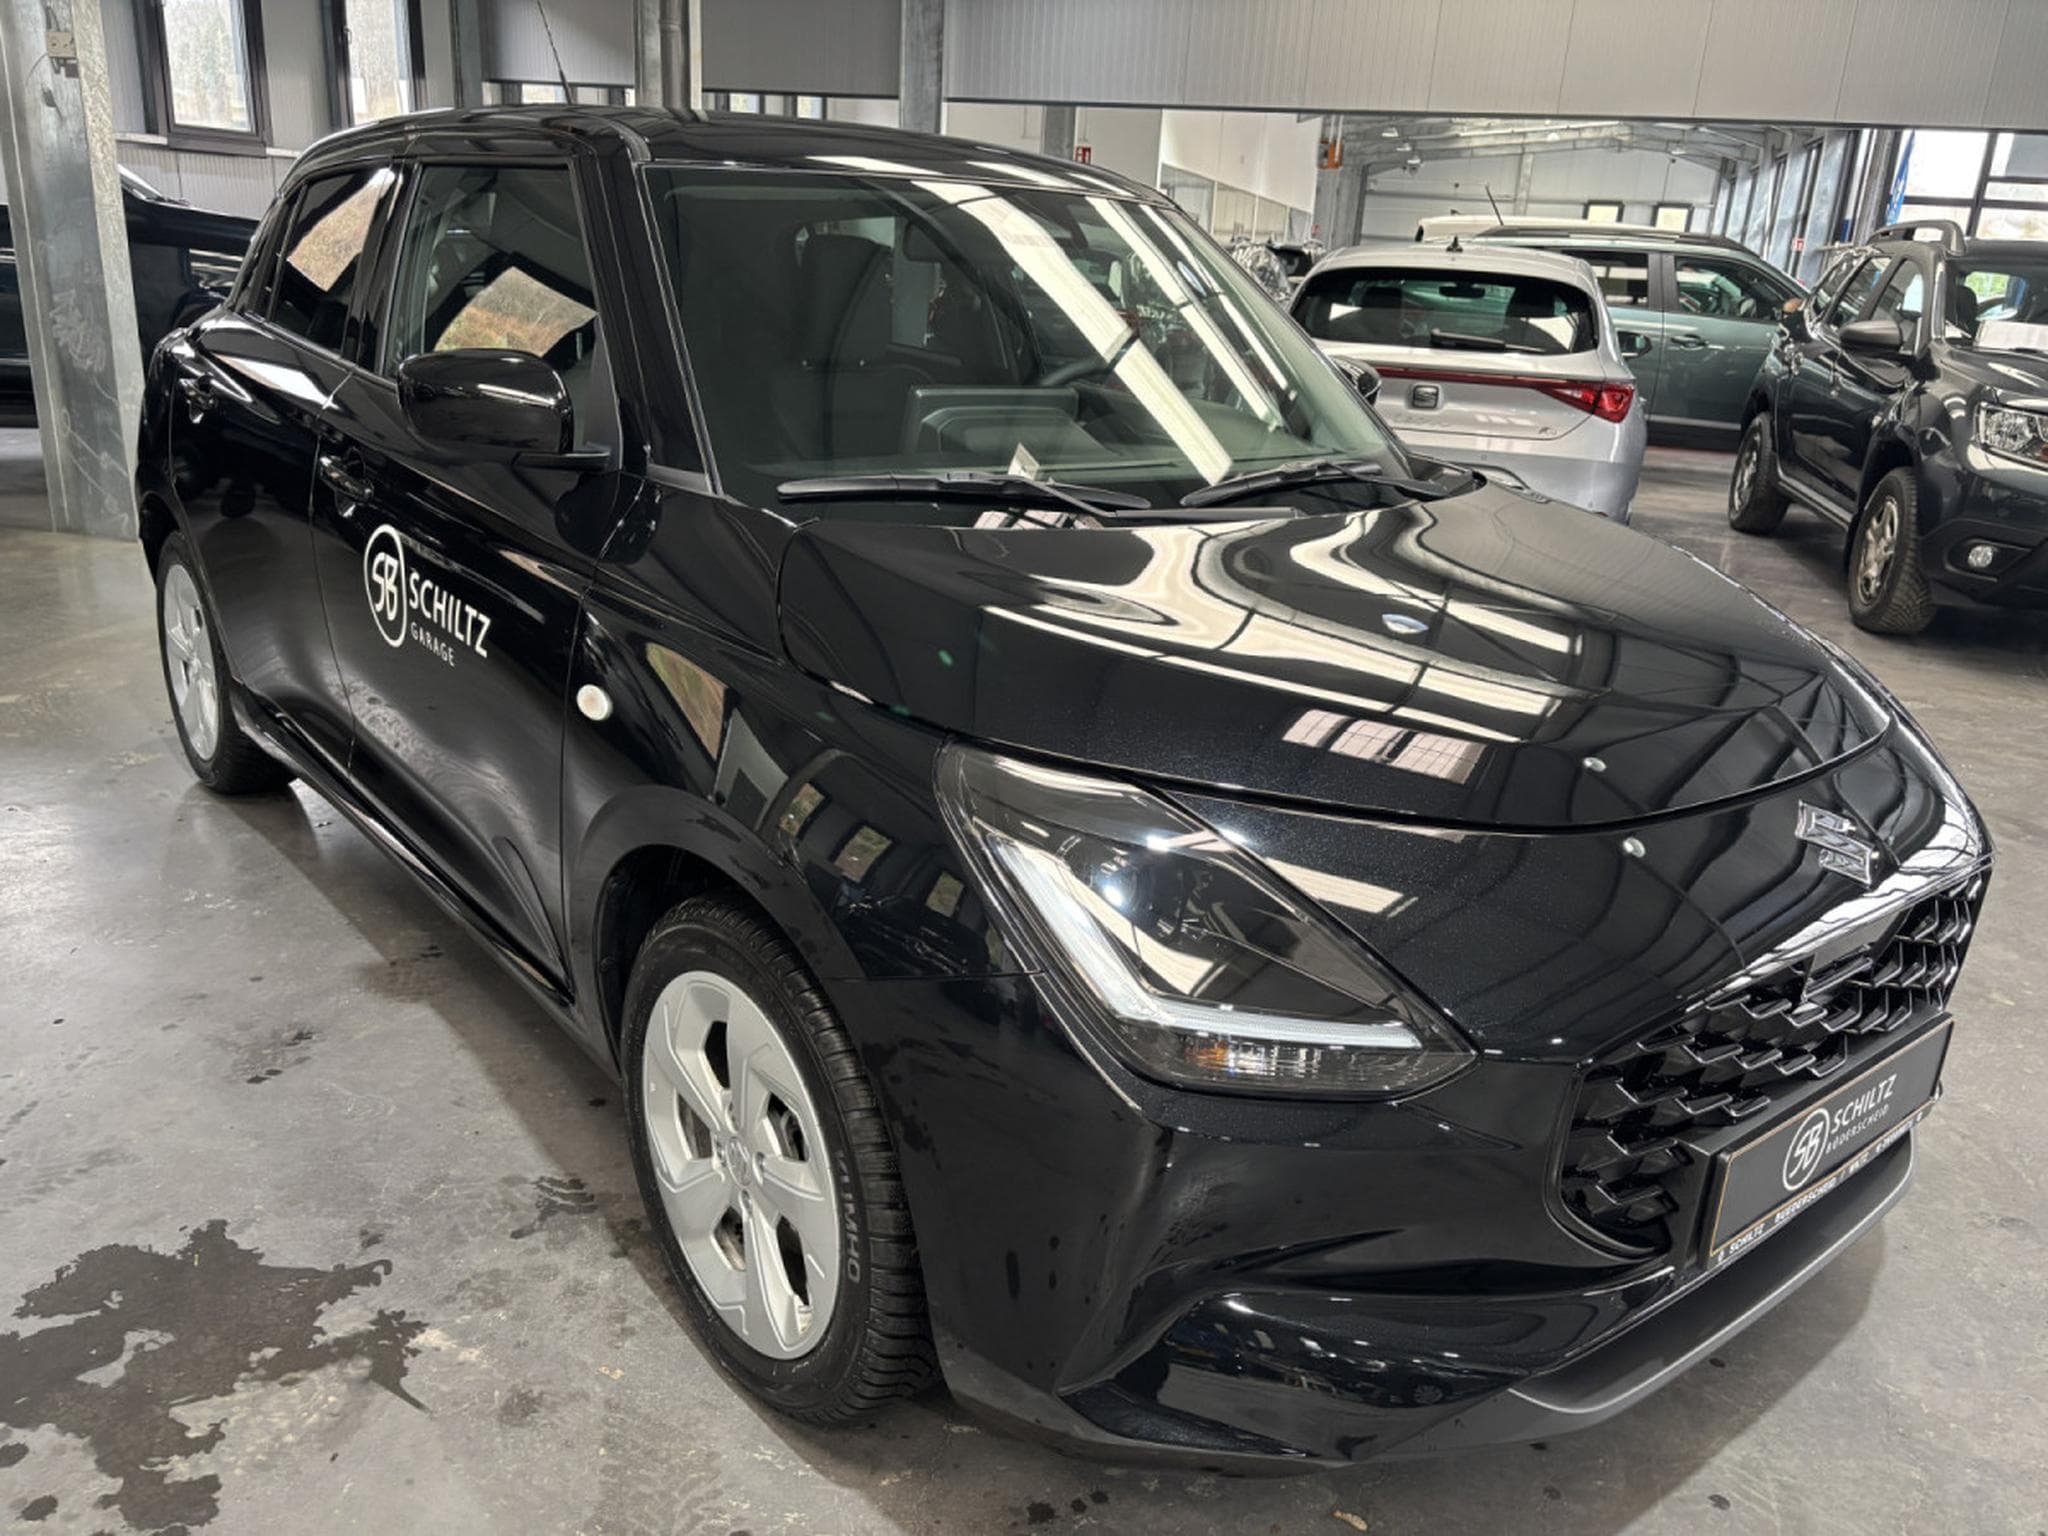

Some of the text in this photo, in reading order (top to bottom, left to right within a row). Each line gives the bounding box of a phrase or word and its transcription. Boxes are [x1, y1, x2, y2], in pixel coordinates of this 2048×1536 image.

[409, 570, 491, 658] SCHILTZ
[410, 621, 455, 667] GARAGE
[1830, 1073, 1897, 1135] SCHILTZ
